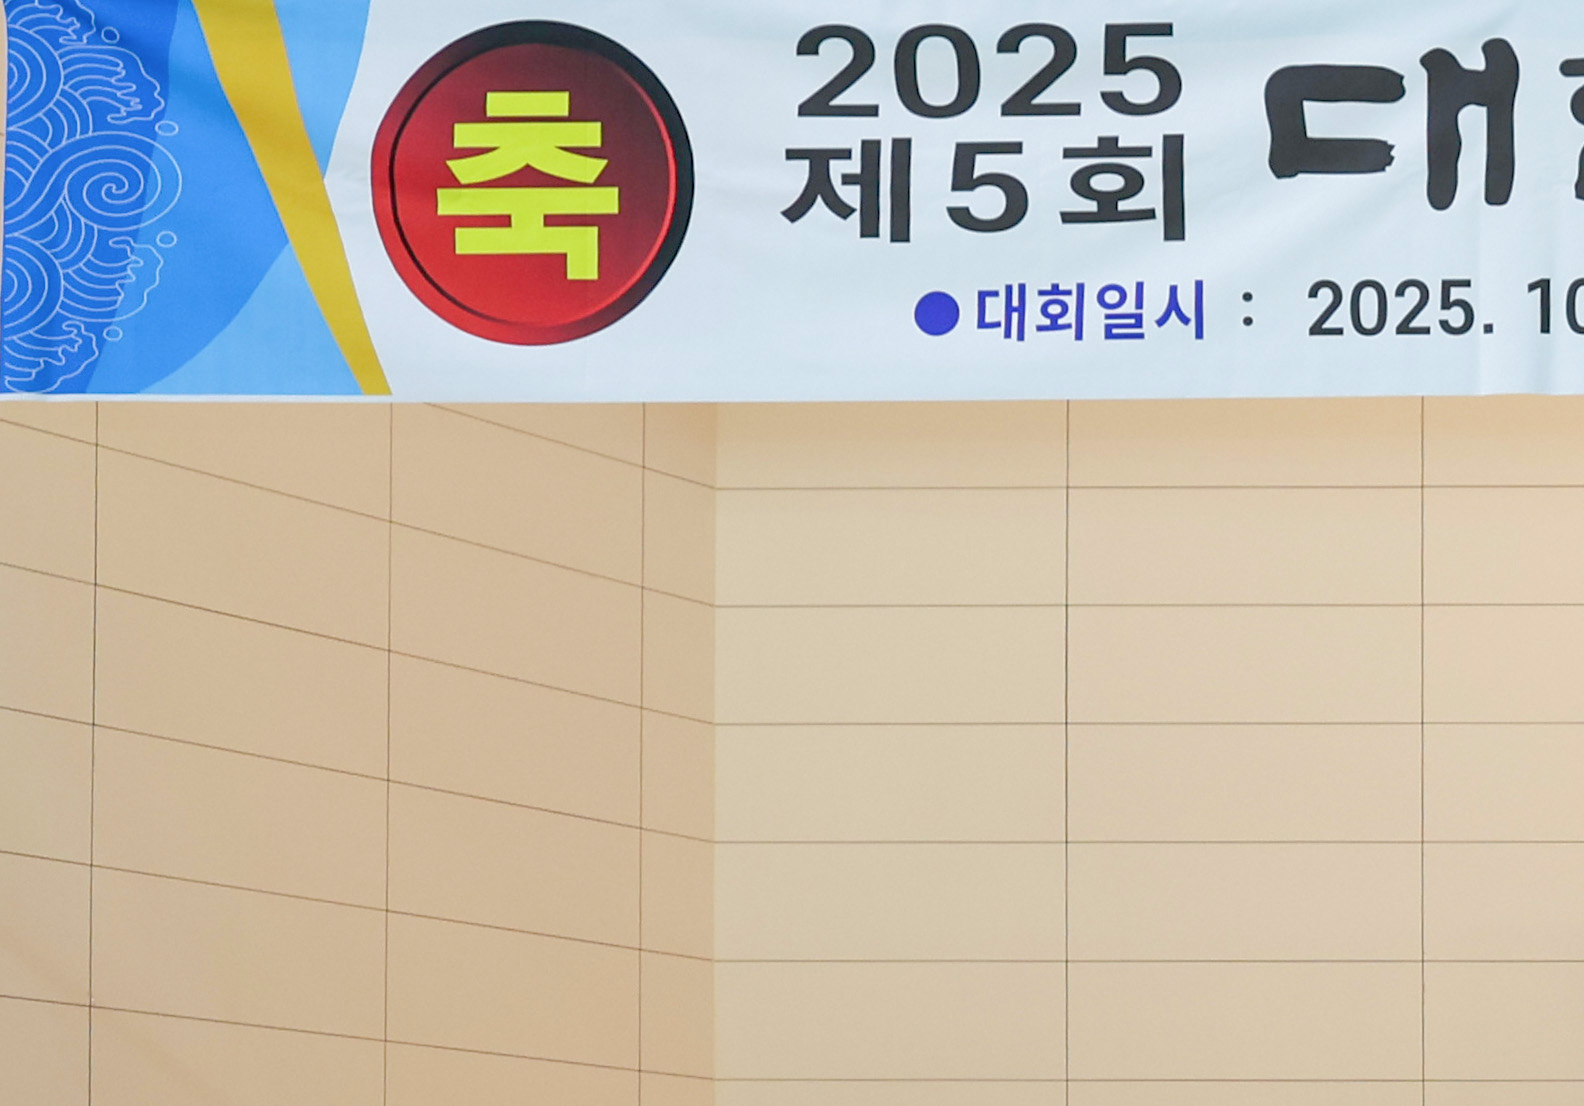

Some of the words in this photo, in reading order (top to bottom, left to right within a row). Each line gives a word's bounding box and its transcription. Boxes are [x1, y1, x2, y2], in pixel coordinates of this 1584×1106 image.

[797, 23, 1182, 118] 2025
[438, 92, 618, 280] 축
[781, 135, 1186, 243] 제5회
[976, 280, 1204, 341] 대회일시
[1308, 279, 1493, 335] 2025.
